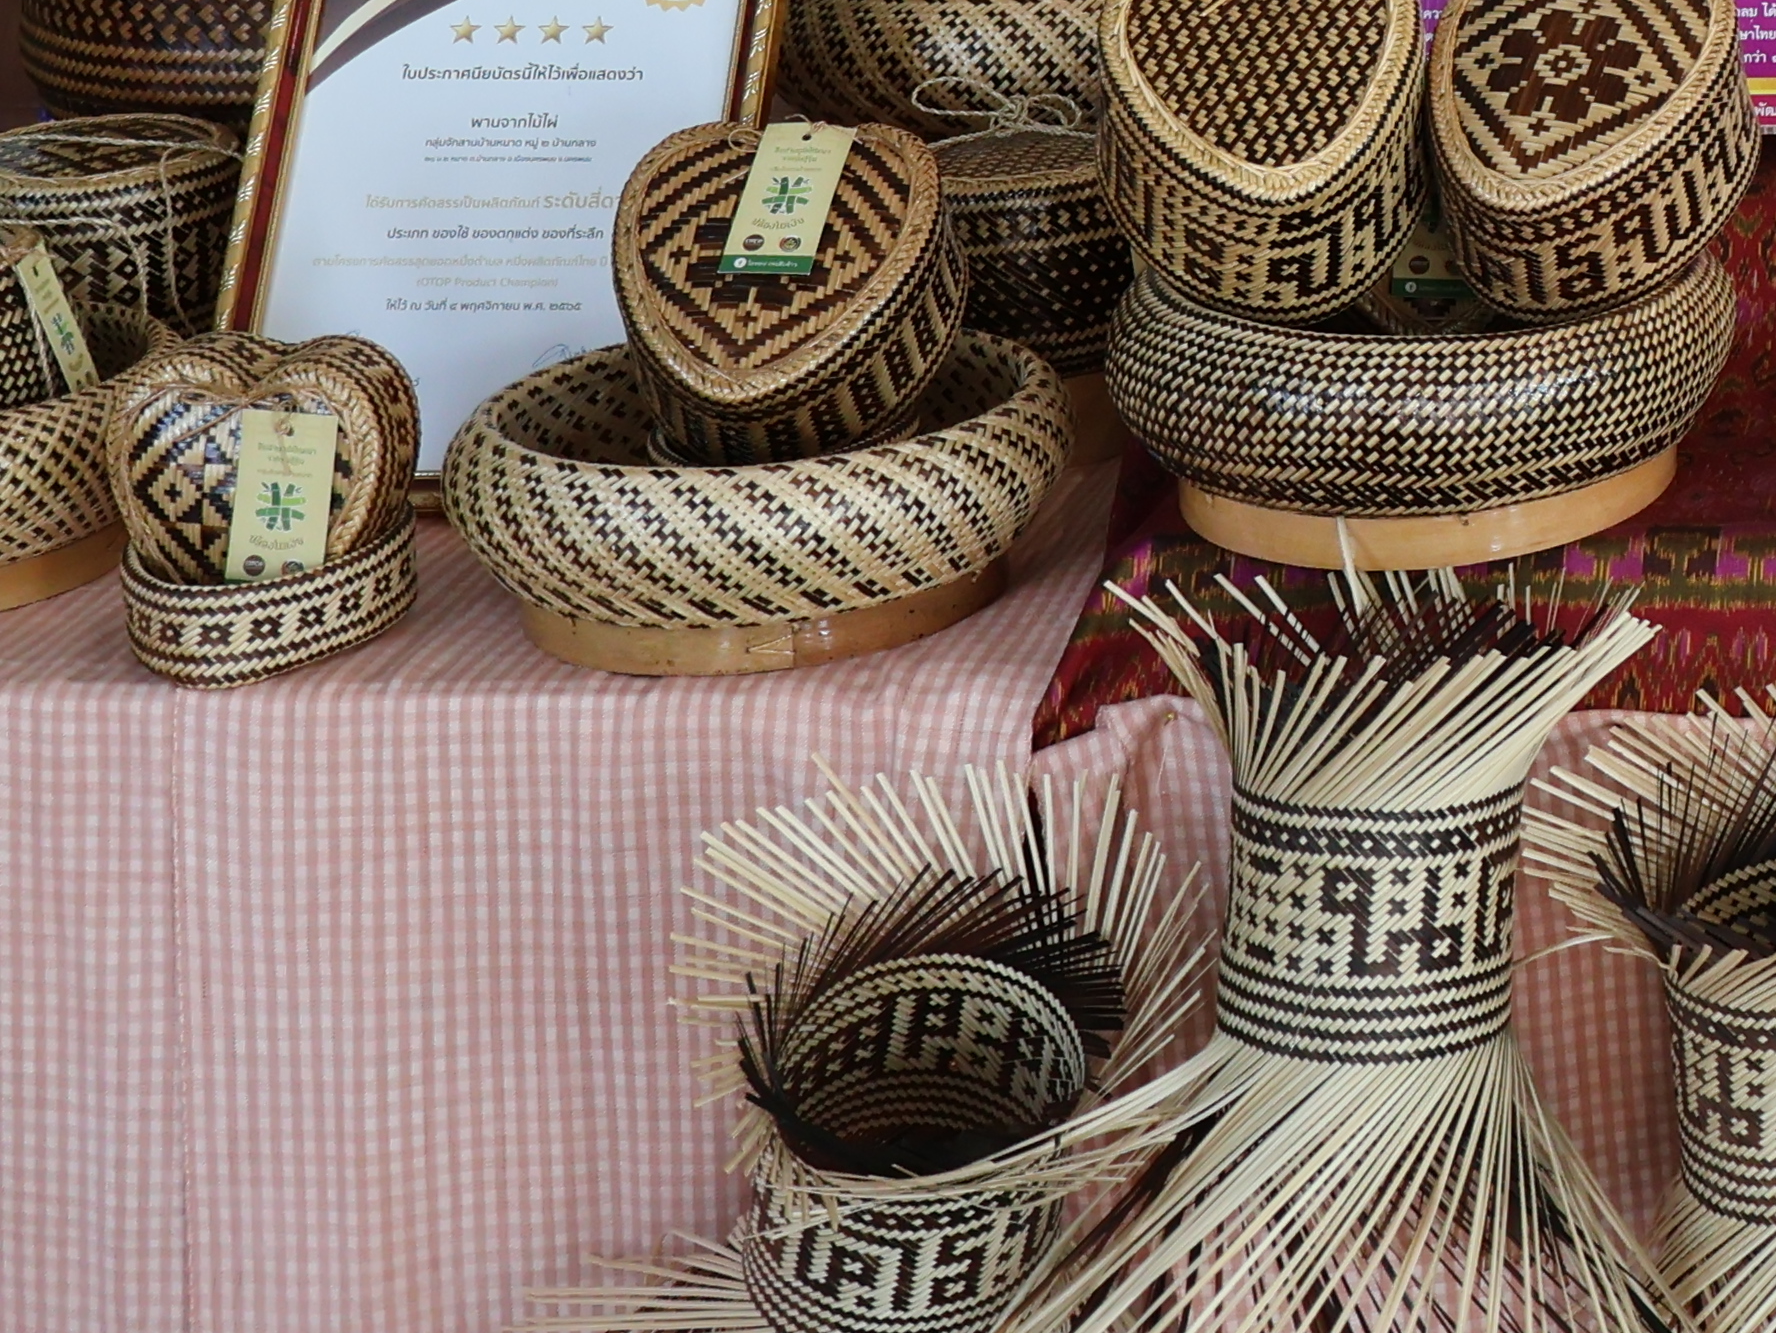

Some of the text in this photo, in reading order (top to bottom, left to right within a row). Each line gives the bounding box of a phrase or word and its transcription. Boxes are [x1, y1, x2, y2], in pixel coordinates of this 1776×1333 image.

[403, 62, 643, 80] ใบประกาศนียบัตรนี้ให้ไว้เพื่อแสดงว่า
[472, 113, 558, 128] พานจากไม้ไผ่
[552, 138, 596, 147] บ้านกลาง
[387, 224, 603, 241] ประเภท ของใช้ ของตกแต่ง ของที่ระลึก
[386, 298, 407, 310] ให้ไว้
[410, 302, 422, 310] ณ
[425, 298, 447, 310] วันที่
[461, 301, 520, 313] พฤศจิกายน
